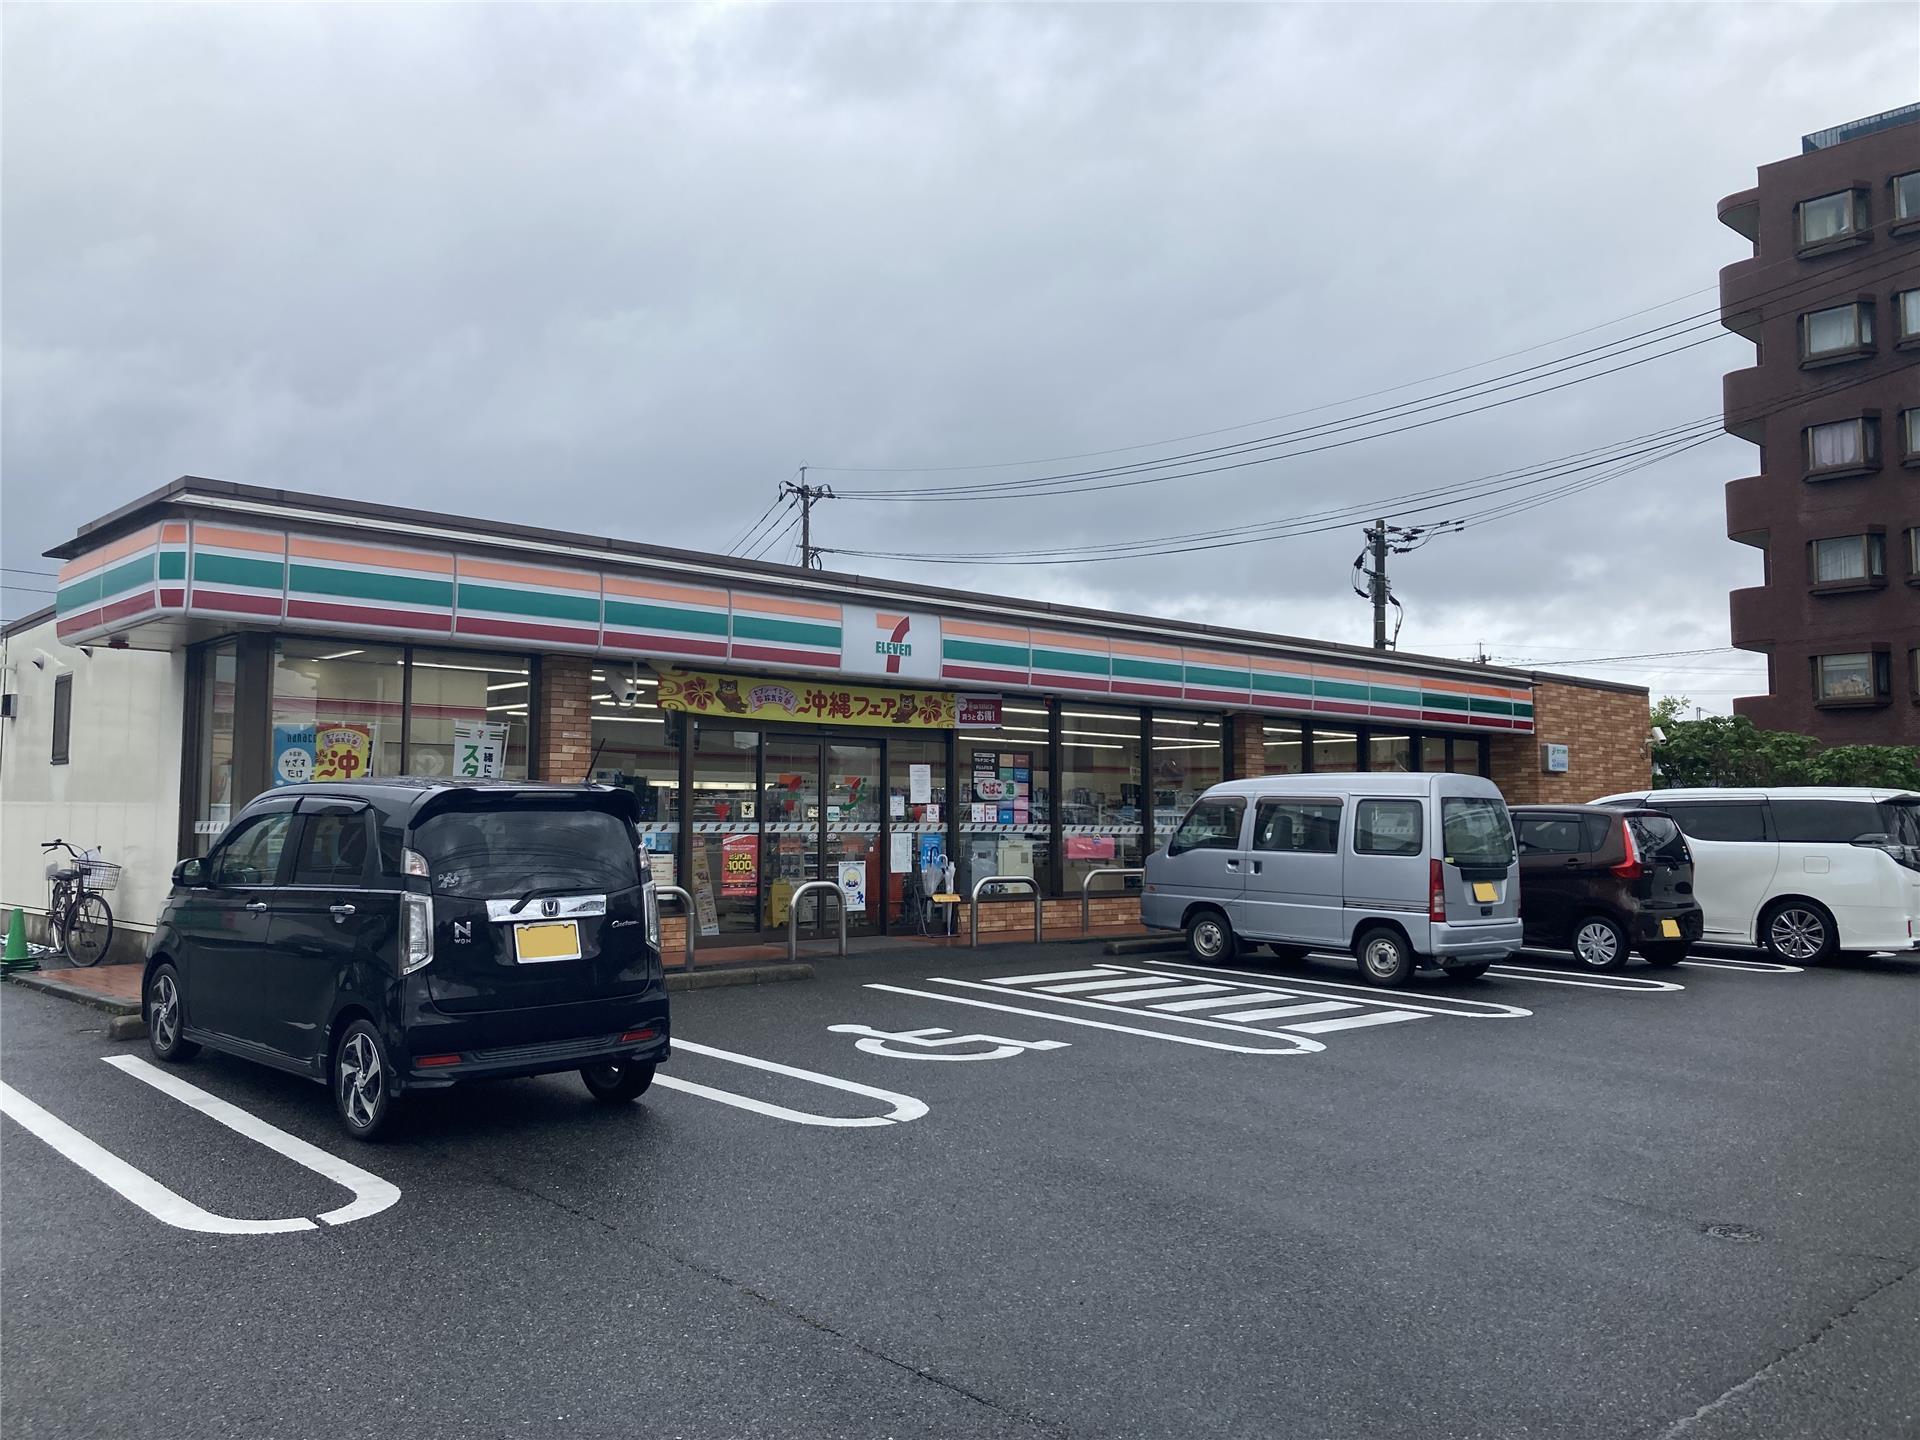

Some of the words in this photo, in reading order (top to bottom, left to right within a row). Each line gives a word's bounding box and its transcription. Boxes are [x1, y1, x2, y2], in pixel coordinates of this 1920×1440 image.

[796, 689, 897, 719] 沖縄フェア
[317, 749, 360, 779] 沖
[483, 746, 494, 778] 一緒に
[982, 782, 1002, 795] たばこ
[1005, 782, 1015, 795] 酒
[728, 860, 752, 871] 1000
[454, 921, 471, 938] N
